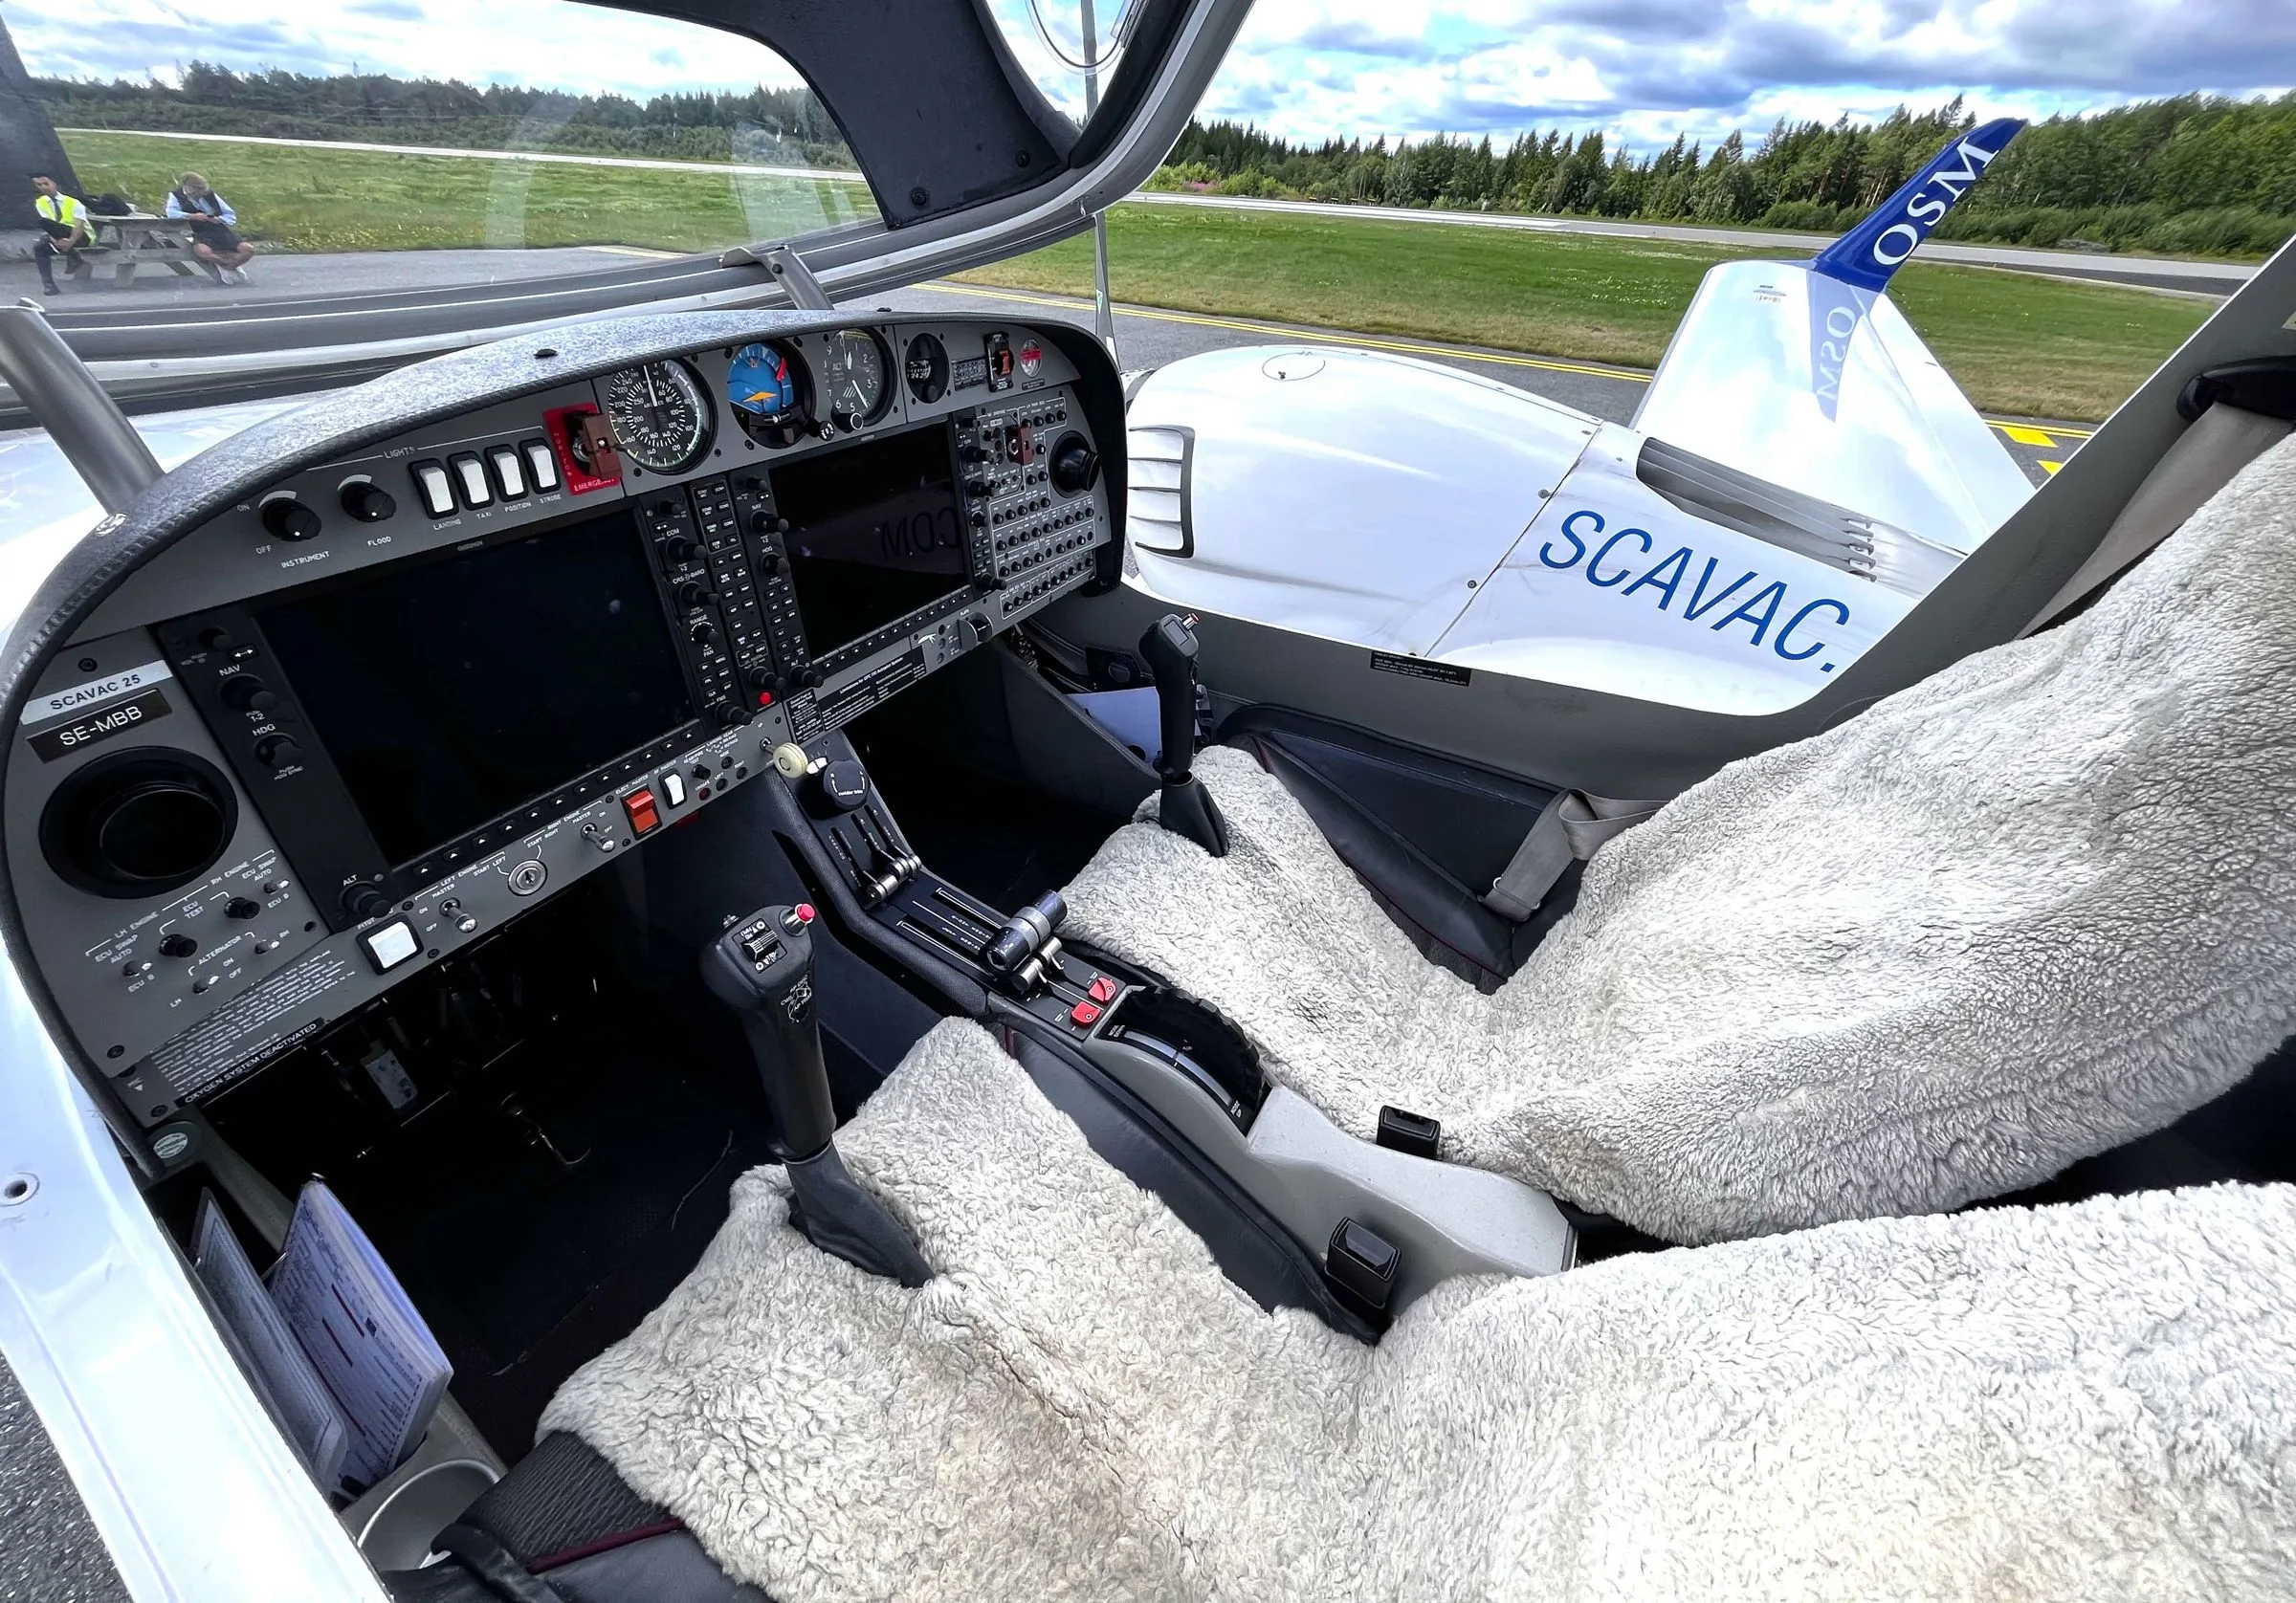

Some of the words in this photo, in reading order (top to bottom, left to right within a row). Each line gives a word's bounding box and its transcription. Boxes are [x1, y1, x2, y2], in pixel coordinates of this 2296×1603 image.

[1872, 137, 1999, 266] OSM
[827, 345, 832, 356] 9
[863, 353, 869, 363] 2
[827, 389, 832, 398] 7
[836, 399, 842, 409] 6
[850, 402, 855, 411] 5
[384, 446, 415, 459] LIGHTS
[574, 478, 615, 492] EMERGE
[504, 501, 532, 513] POSITION
[432, 518, 462, 531] LANDING
[666, 528, 680, 538] COM
[367, 536, 392, 548] FLOOD
[255, 544, 272, 555] OFF
[280, 551, 330, 569] INSTRUMENT
[673, 576, 685, 584] CRS
[1538, 510, 1850, 673] SCAVAC.
[689, 614, 708, 626] RANGE
[218, 665, 240, 676] NAV
[50, 680, 120, 711] SCAVAC
[122, 673, 142, 688] 25
[59, 706, 144, 746] SE-MBB
[253, 723, 276, 736] HDG
[616, 781, 630, 795] ELECT
[631, 774, 649, 786] MASTER
[572, 811, 591, 824] MASTER
[526, 836, 543, 848] START
[543, 828, 560, 840] RIGHT
[224, 861, 251, 878] ENGINE
[241, 868, 256, 880] ECU
[258, 857, 276, 870] SWAP
[473, 864, 492, 877] START
[492, 856, 507, 868] LEFT
[254, 868, 272, 882] AUTO
[342, 874, 358, 887] ALT
[440, 875, 456, 887] LEFT
[457, 865, 478, 878] ENGINE
[431, 884, 455, 899] MASTER
[182, 901, 199, 912] ECU
[268, 897, 281, 909] ECU
[185, 906, 205, 919] TEST
[114, 929, 128, 939] LH
[130, 911, 159, 931] ENGINE
[357, 917, 376, 931] PITOT
[426, 922, 438, 933] OFF
[94, 949, 113, 962] ECU
[115, 933, 139, 951] SWAP
[198, 935, 242, 965] ALTERNATOR
[111, 948, 132, 964] AUTO
[222, 957, 234, 968] ON
[229, 967, 242, 979] OFF
[128, 979, 145, 993] ECU
[170, 998, 182, 1008] LH
[185, 1077, 224, 1104] OXYGEN
[223, 1057, 260, 1083] SYSTEM
[259, 1022, 318, 1060] DEACTIVATED
